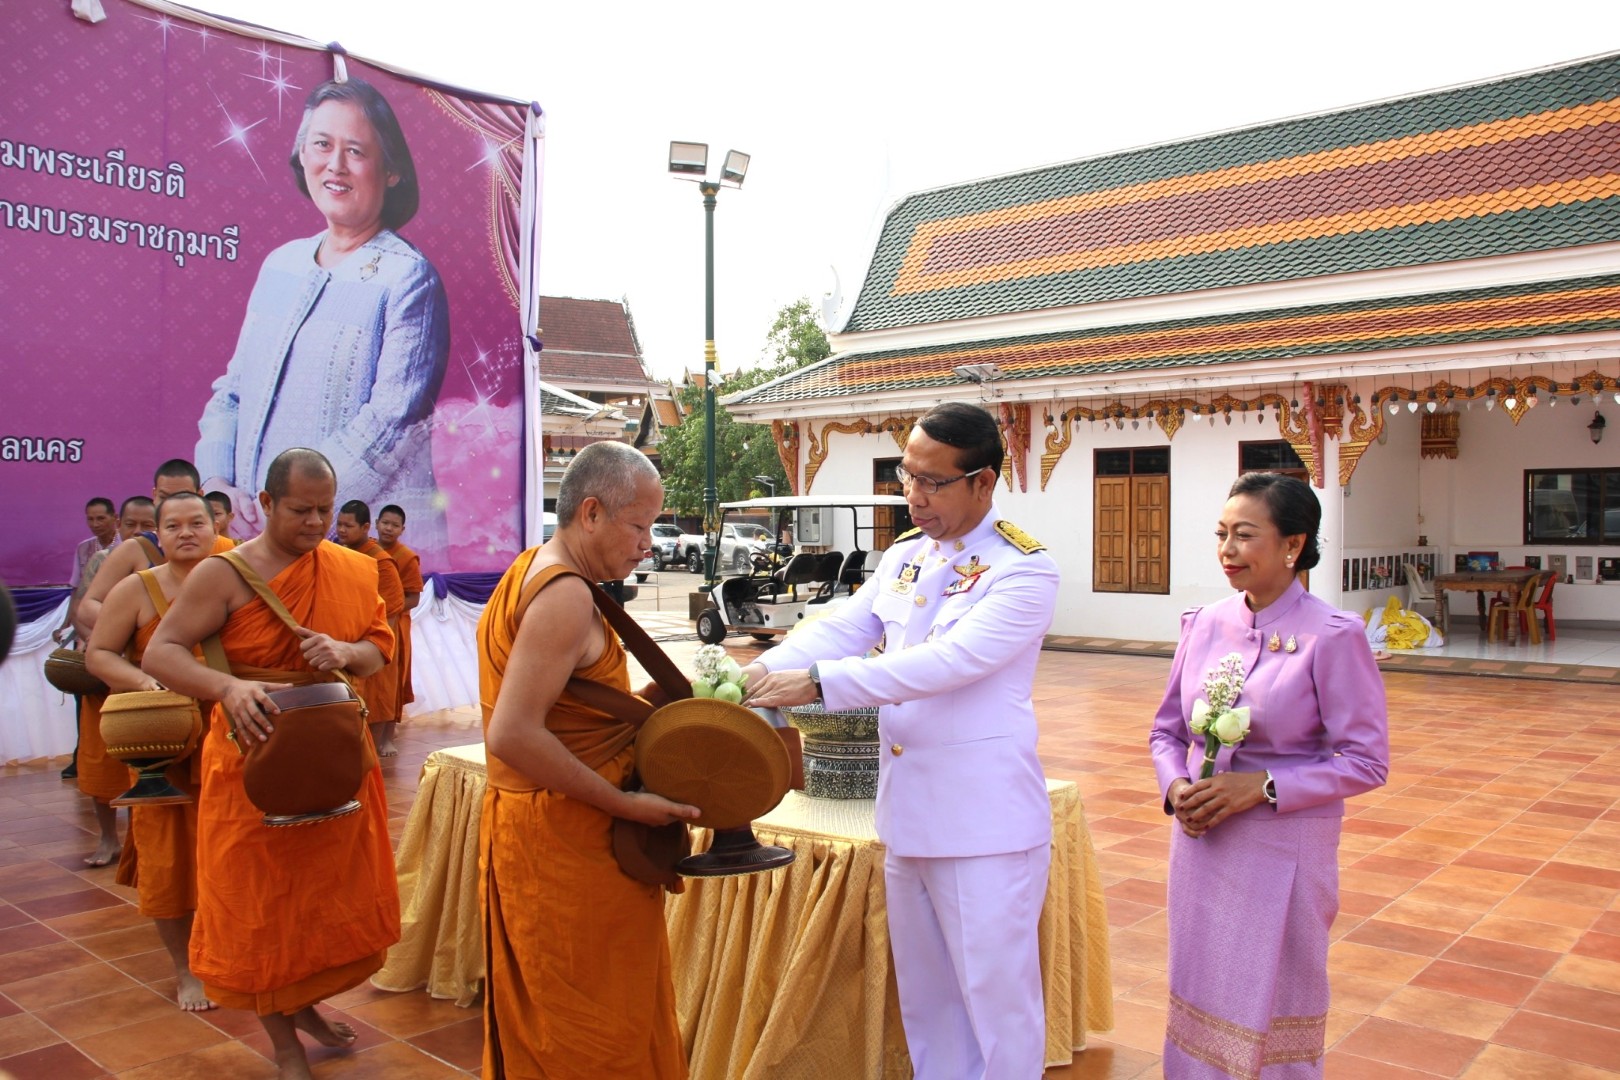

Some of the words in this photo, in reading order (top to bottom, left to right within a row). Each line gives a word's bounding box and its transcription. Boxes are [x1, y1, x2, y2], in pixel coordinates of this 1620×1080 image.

[0, 141, 185, 197] มพระเกียรติ
[0, 201, 239, 266] ามบรมราชกุมารี
[2, 437, 84, 462] ลนคร
